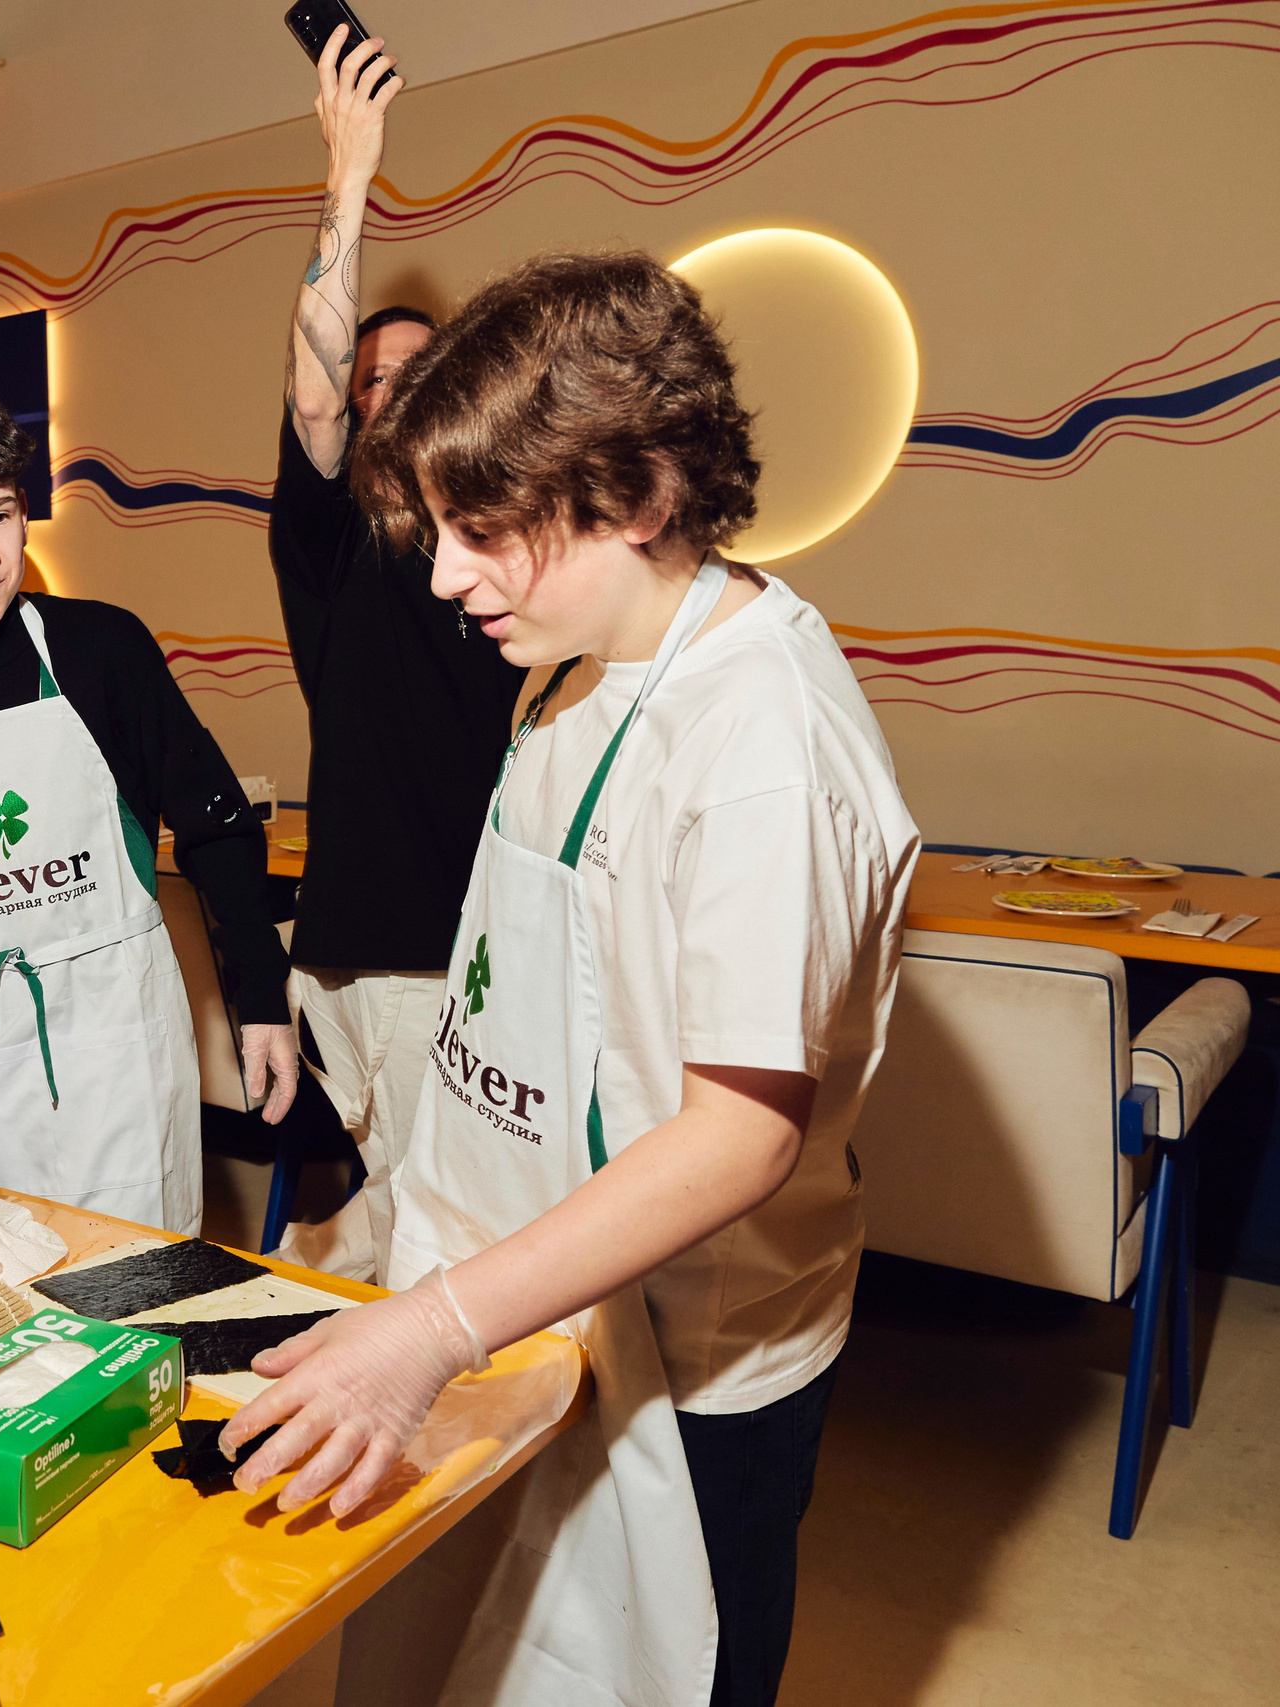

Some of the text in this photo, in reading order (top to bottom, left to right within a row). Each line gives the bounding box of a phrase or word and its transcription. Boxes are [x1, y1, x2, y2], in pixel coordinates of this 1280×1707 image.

[47, 880, 98, 906] студия
[434, 994, 546, 1123] lever
[477, 1102, 543, 1146] студия
[11, 1315, 89, 1348] 50
[149, 1359, 173, 1403] 50
[148, 1402, 176, 1431] защиты
[149, 1399, 163, 1417] пар
[34, 1438, 70, 1472] Optiline
